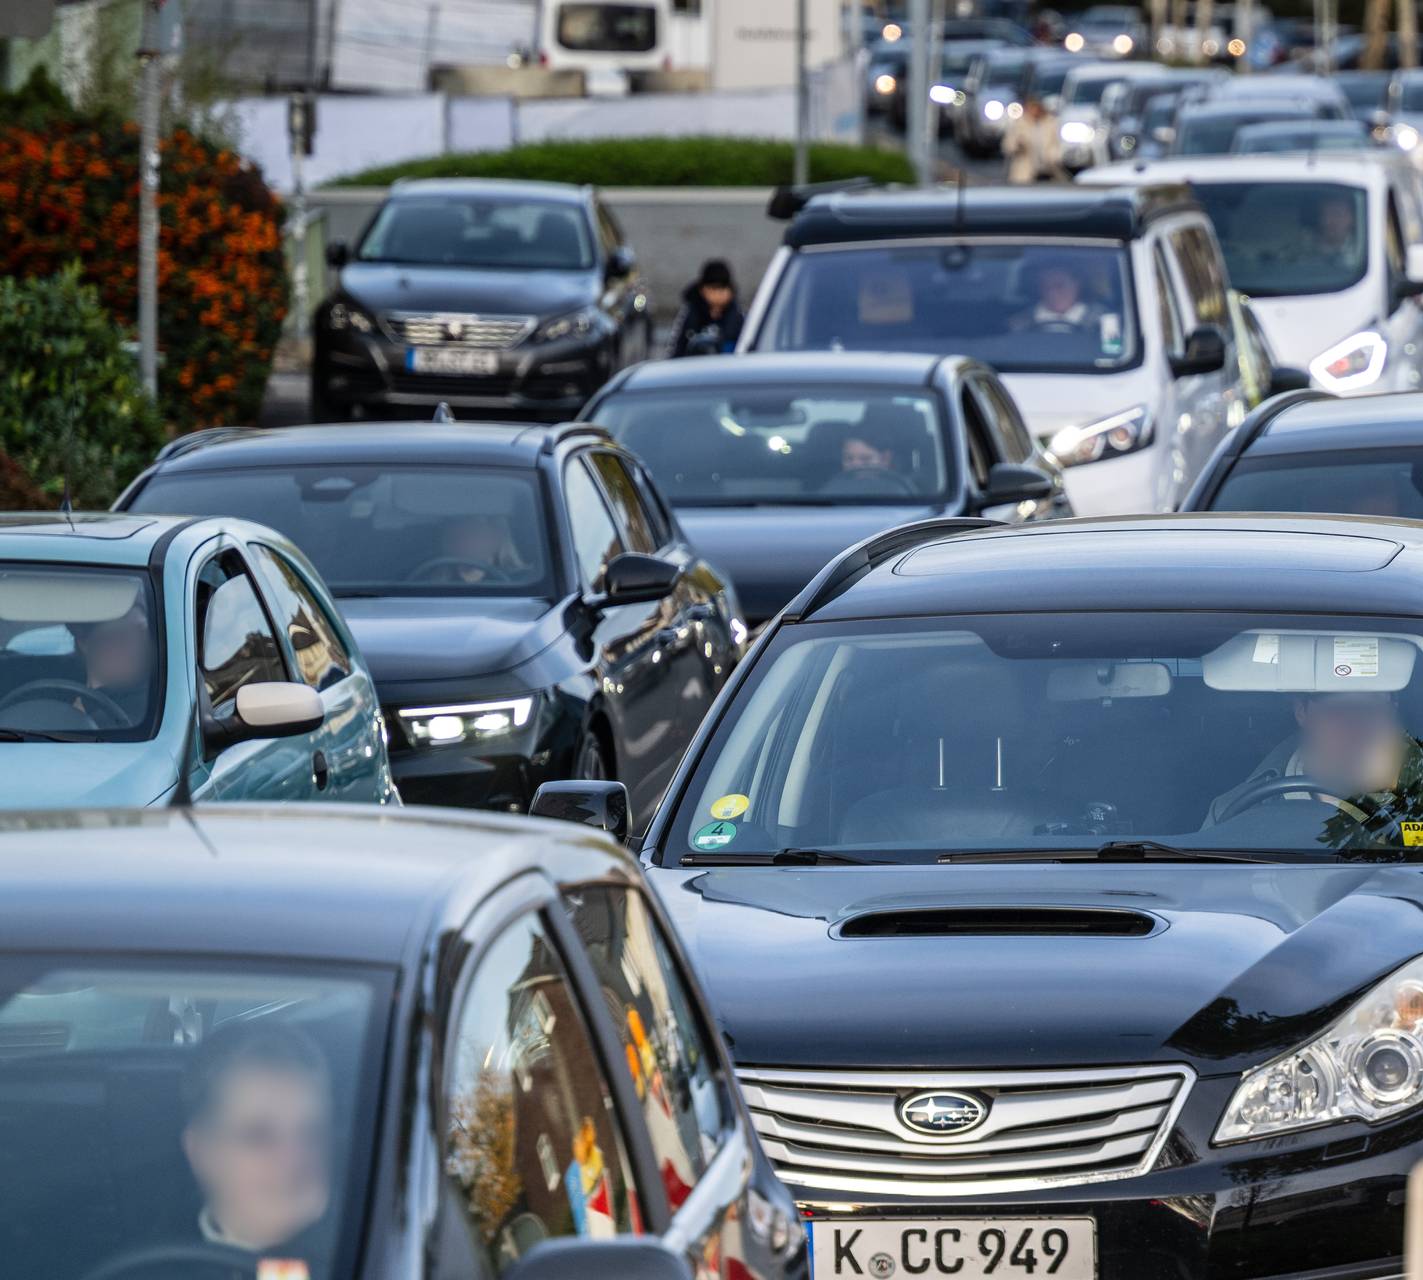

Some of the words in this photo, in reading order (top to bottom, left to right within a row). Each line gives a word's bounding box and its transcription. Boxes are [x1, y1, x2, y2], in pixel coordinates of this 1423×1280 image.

[711, 822, 724, 835] 4
[833, 1229, 864, 1275] K
[901, 1228, 965, 1275] CC
[978, 1228, 1070, 1275] 949
